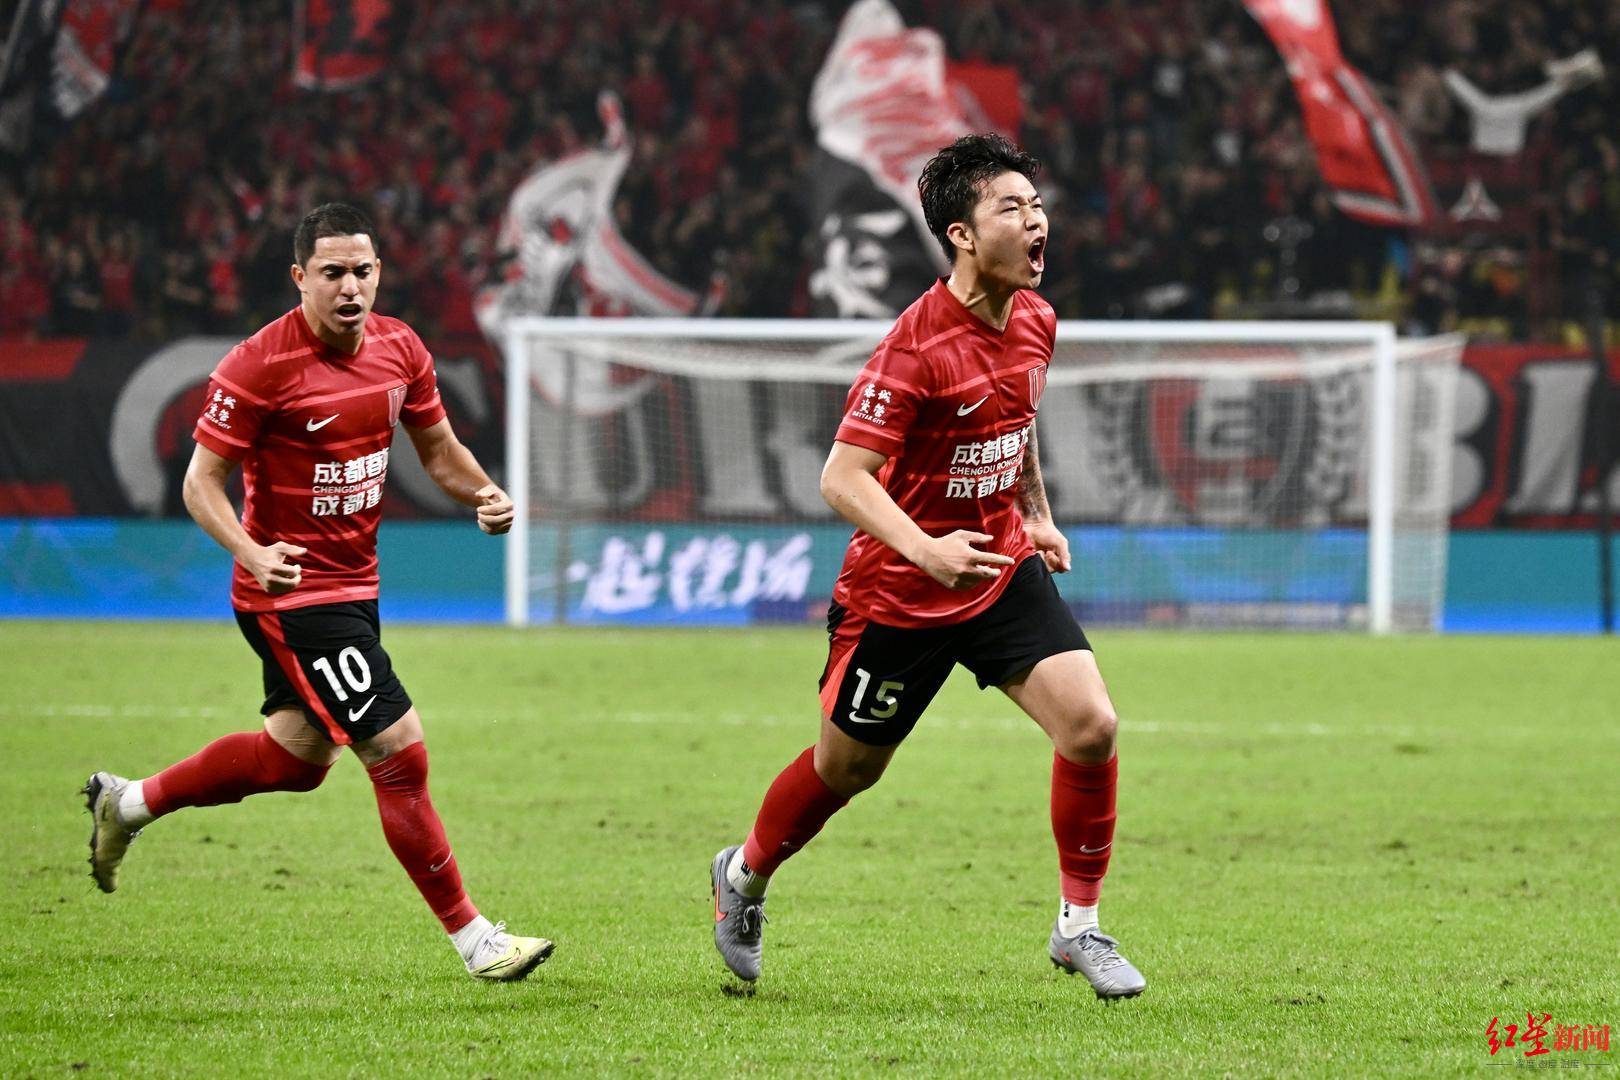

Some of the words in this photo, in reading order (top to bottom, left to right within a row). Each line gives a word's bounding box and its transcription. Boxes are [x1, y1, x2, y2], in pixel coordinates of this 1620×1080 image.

[945, 464, 1023, 499] 成都建
[949, 464, 996, 476] CHENGDU
[312, 483, 362, 494] CHENGDU
[312, 646, 372, 701] 10
[851, 667, 904, 719] 15
